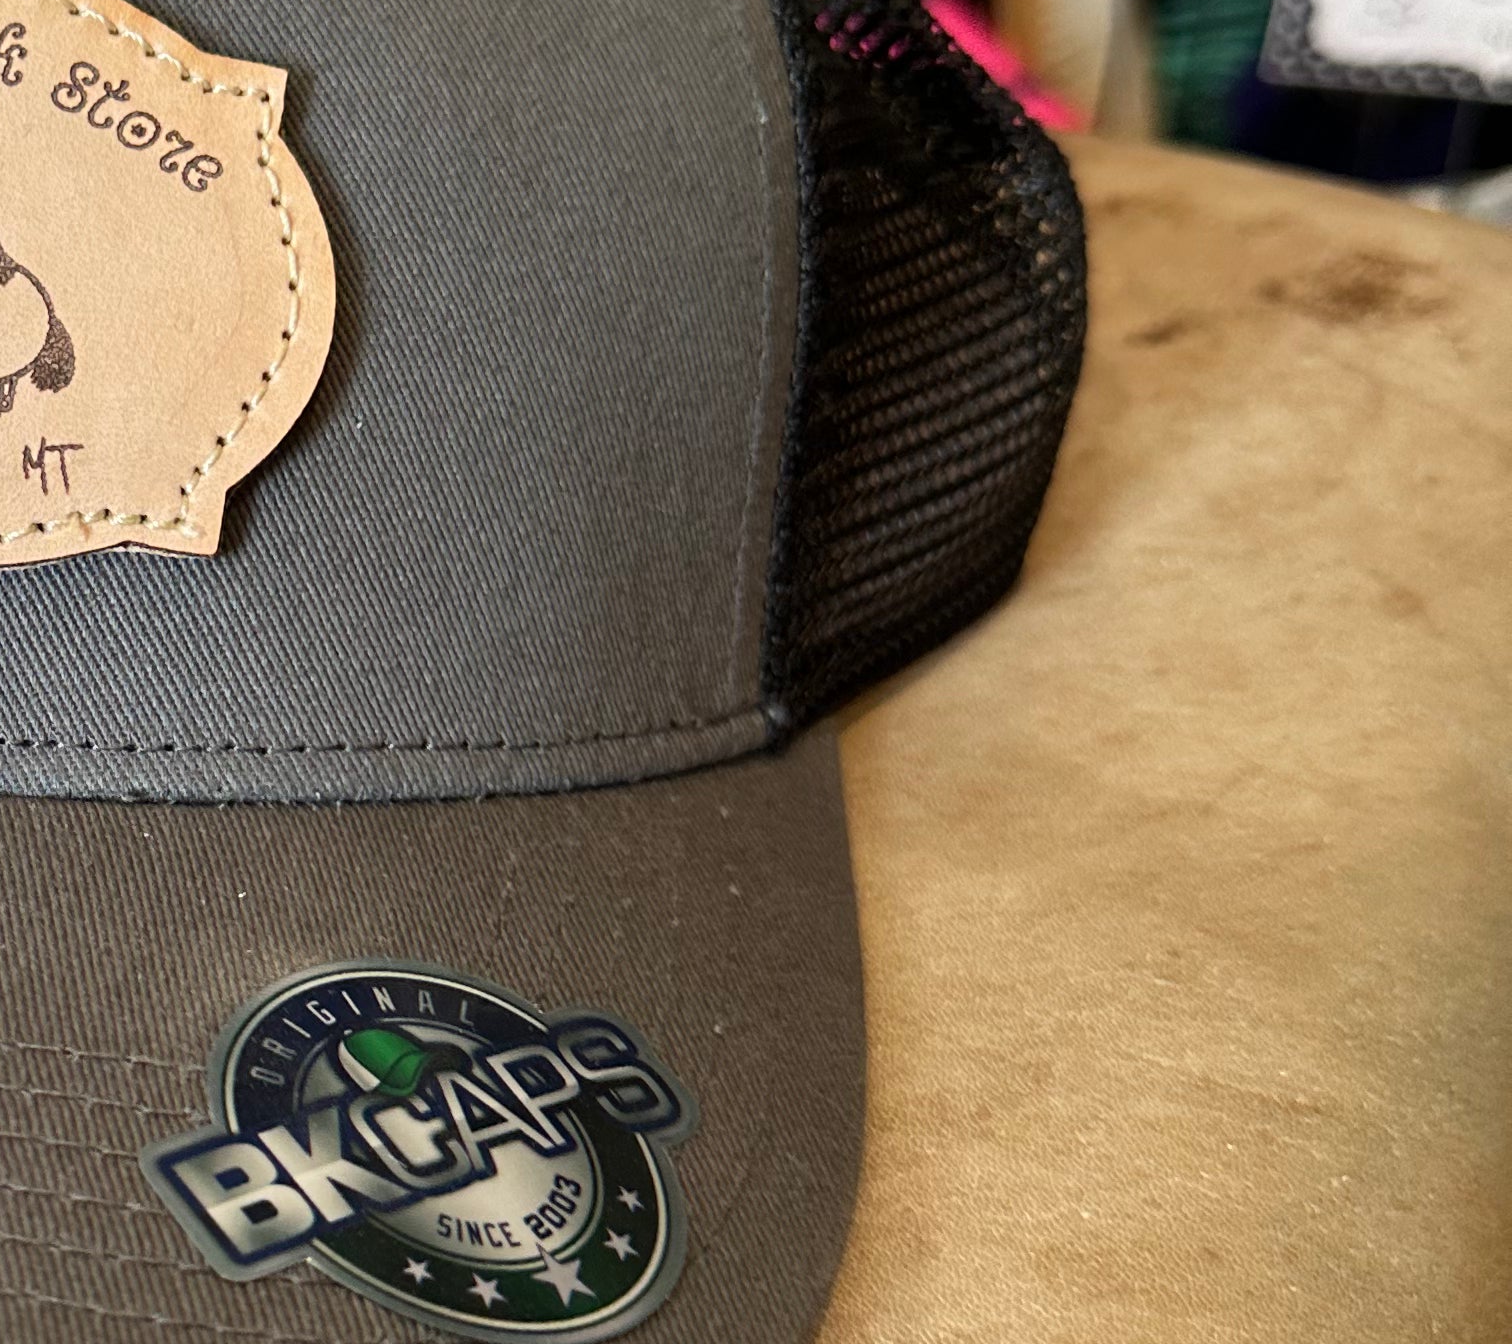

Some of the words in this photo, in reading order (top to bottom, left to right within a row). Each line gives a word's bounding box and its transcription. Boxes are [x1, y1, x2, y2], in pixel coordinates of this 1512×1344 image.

[51, 61, 225, 193] Store
[22, 436, 85, 495] MT
[250, 985, 476, 1087] ORIGINAL
[436, 1213, 521, 1249] SINCE
[524, 1173, 583, 1241] 2003
